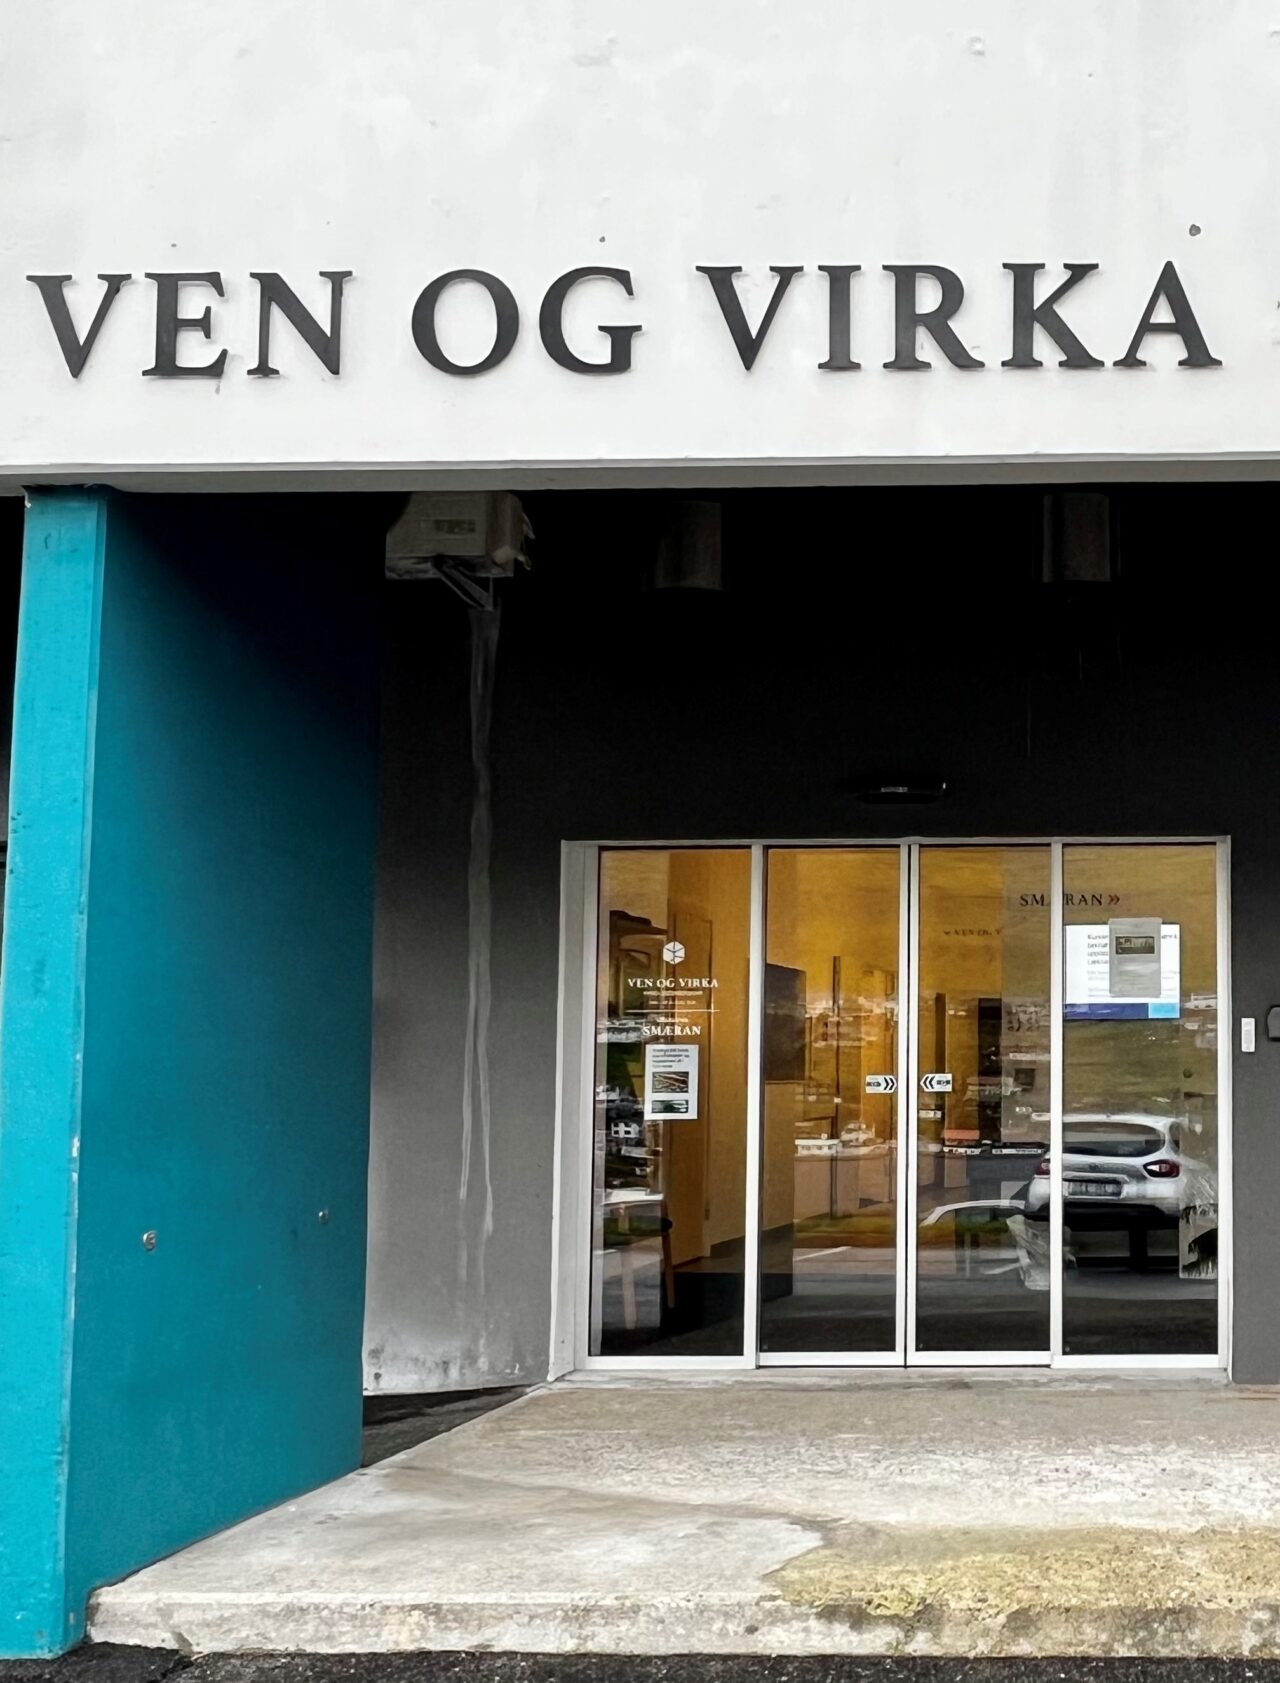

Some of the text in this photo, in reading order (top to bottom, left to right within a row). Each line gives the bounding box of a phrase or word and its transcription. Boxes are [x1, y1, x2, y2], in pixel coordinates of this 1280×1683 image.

[26, 260, 1223, 379] VEN OG VIRKA
[1019, 892, 1104, 908] SMRAN
[627, 978, 718, 988] VEN OG VIRKA
[641, 1025, 701, 1036] SMÆRAN
